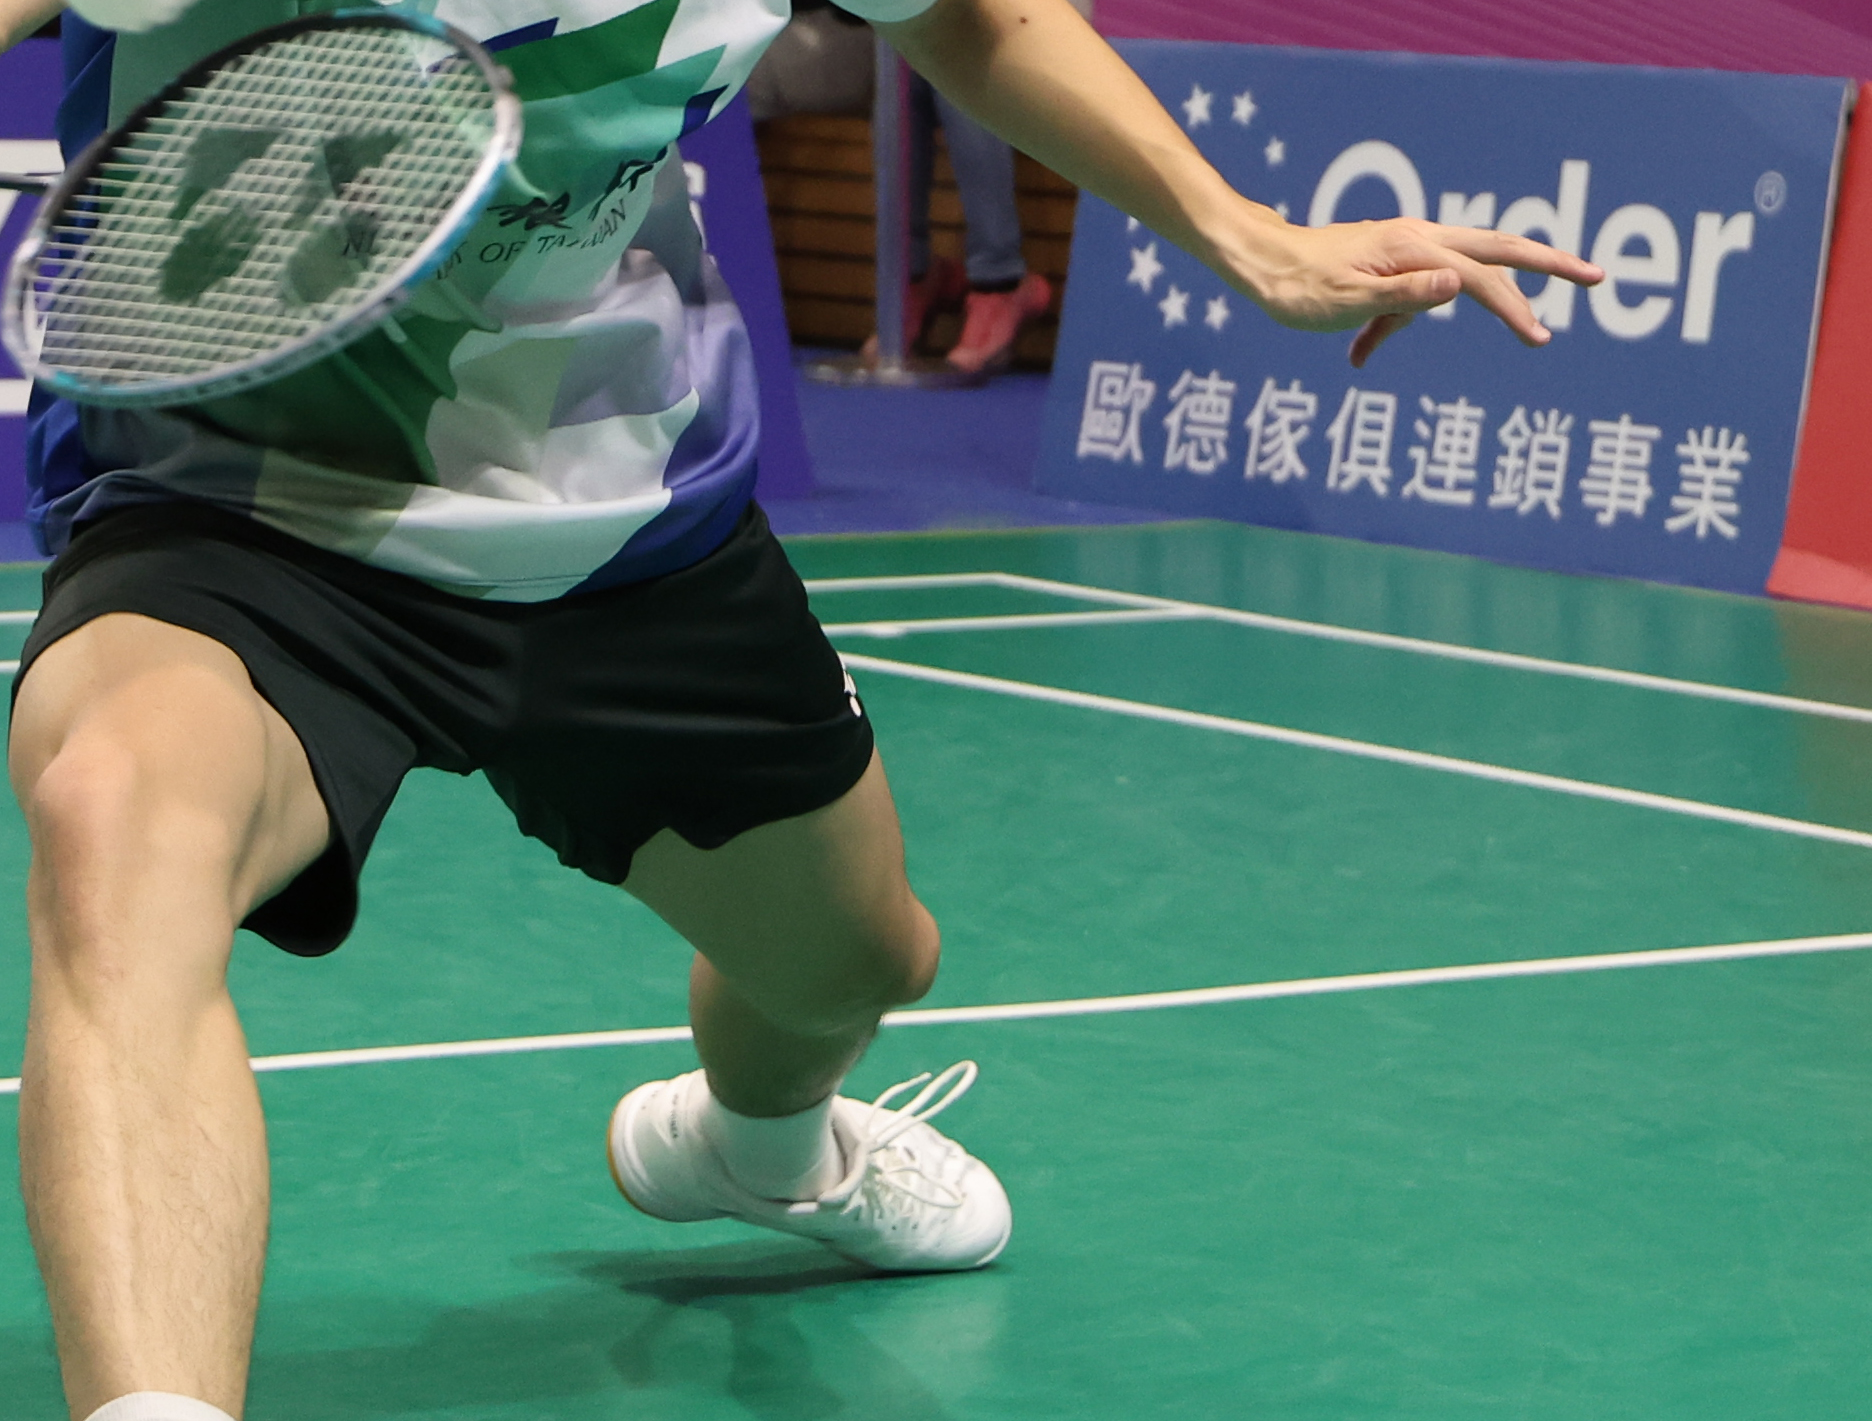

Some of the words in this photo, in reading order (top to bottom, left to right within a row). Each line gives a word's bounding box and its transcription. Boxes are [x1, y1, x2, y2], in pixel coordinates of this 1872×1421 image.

[480, 240, 528, 263] OF
[1076, 360, 1750, 540] 歐德傢俱連鎖事業
